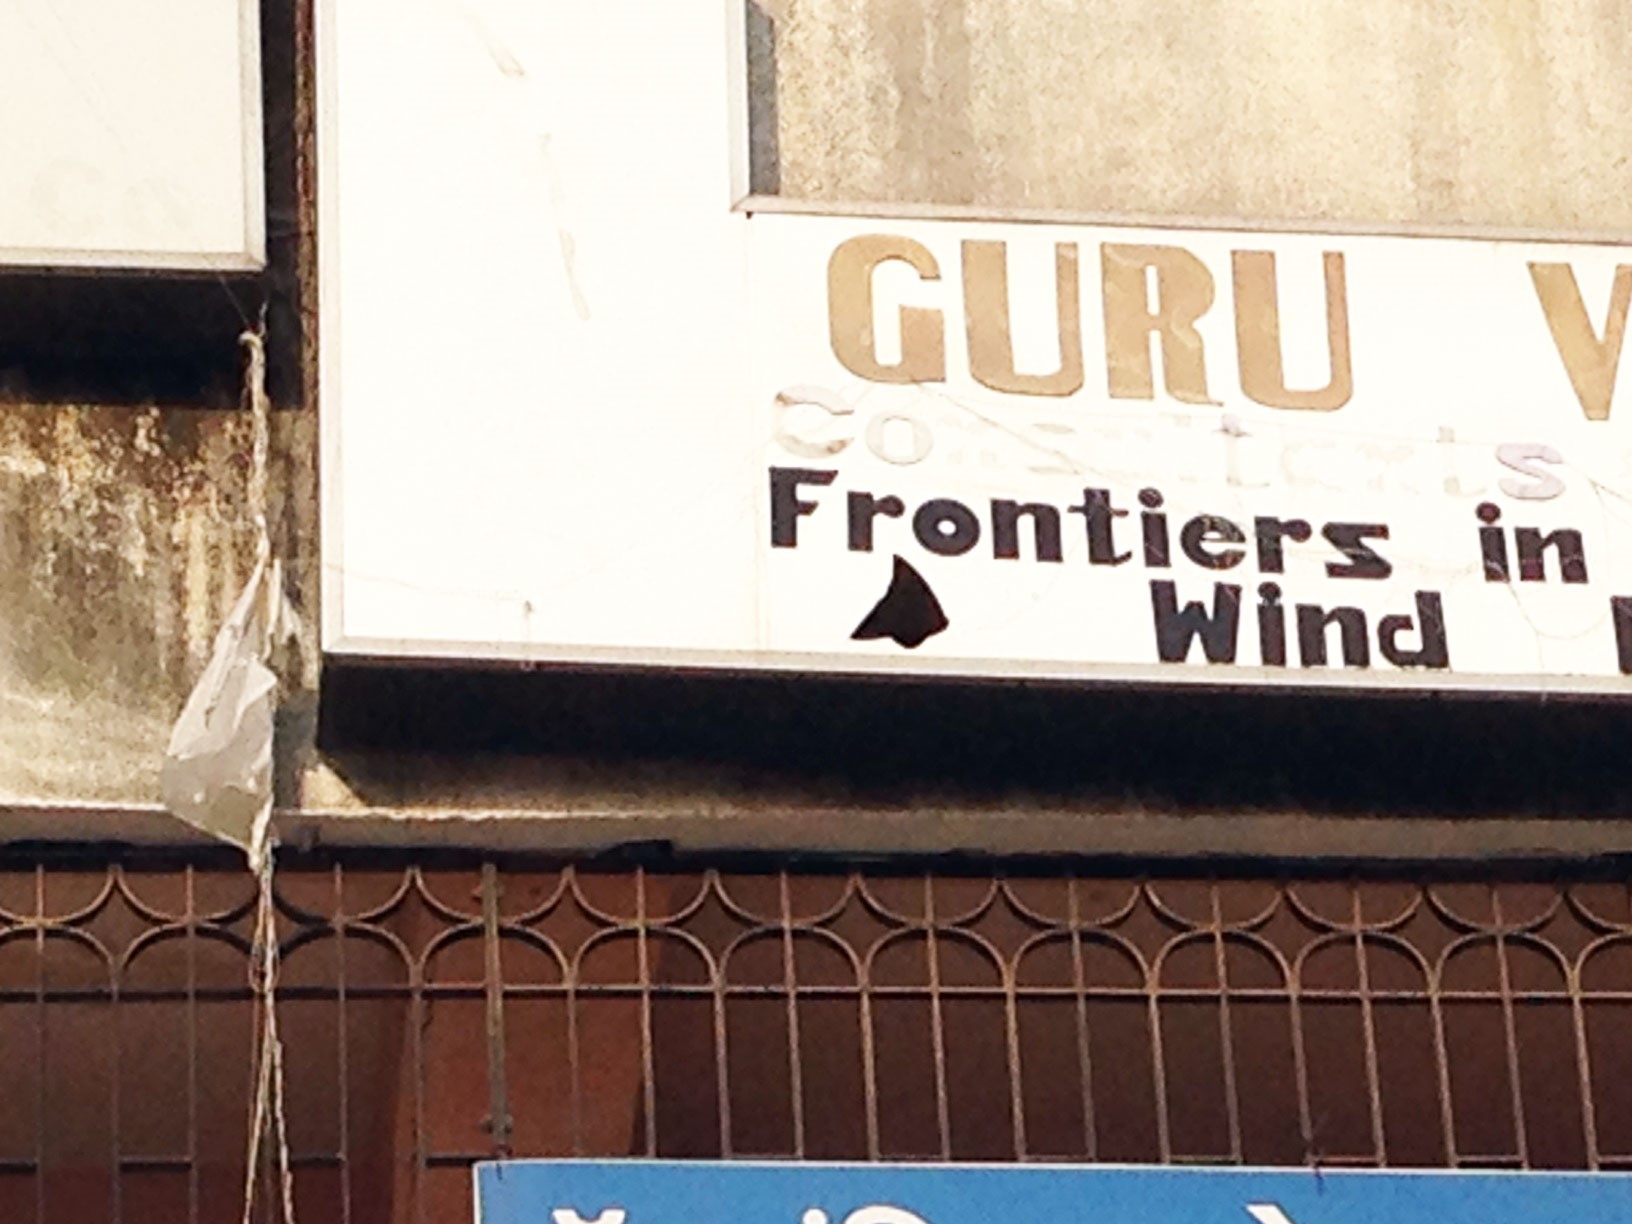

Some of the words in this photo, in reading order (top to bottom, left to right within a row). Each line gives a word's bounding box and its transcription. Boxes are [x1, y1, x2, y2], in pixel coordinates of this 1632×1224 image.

[827, 234, 1353, 411] GURU
[770, 468, 1392, 578] Frontiers
[1477, 504, 1587, 583] in
[1151, 579, 1448, 668] Wind
